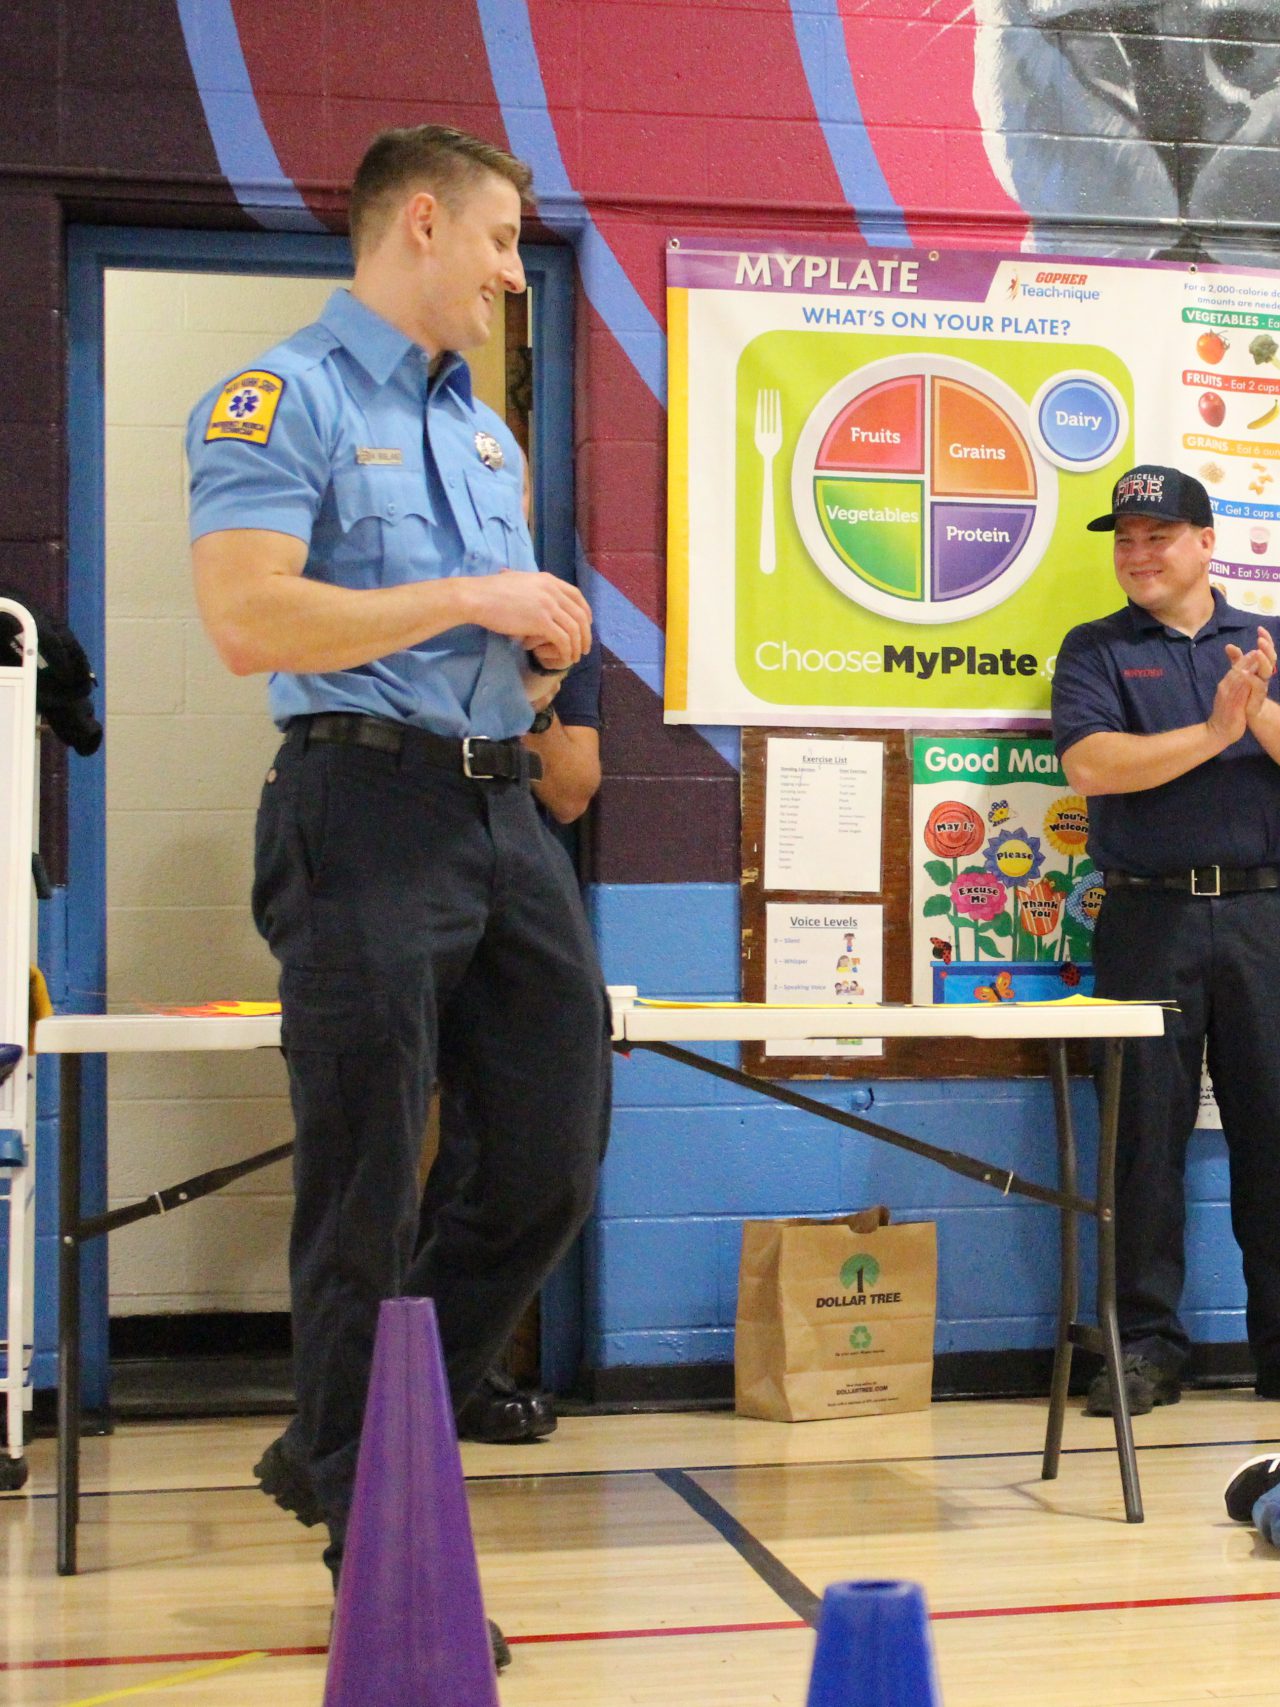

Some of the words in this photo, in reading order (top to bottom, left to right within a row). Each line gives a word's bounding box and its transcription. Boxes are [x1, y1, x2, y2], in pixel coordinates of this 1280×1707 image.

[735, 252, 919, 293] MYPLATE
[1035, 271, 1088, 285] GOPHER
[1198, 297, 1235, 306] amounts
[1237, 299, 1252, 307] are
[802, 307, 885, 327] WHAT'S
[892, 311, 927, 329] ON
[934, 313, 994, 332] YOUR
[1001, 317, 1071, 336] PLATE?
[1186, 309, 1259, 327] VEGETABLES
[1186, 372, 1223, 387] FRUITS
[1231, 379, 1246, 391] Eat
[1249, 381, 1256, 391] 2
[1257, 383, 1279, 394] cups
[1056, 410, 1102, 430] Dairy
[850, 427, 901, 444] Fruits
[949, 443, 1006, 460] Grains
[1186, 436, 1229, 453] GRAINS
[1236, 444, 1251, 454] Eat
[1254, 445, 1260, 455] 6
[826, 505, 919, 525] Vegetables
[1225, 504, 1241, 515] Get
[1244, 506, 1250, 516] 3
[1252, 508, 1274, 519] cups
[946, 526, 1010, 543] Protein
[1238, 567, 1252, 578] Eat
[802, 755, 833, 764] Exercise
[835, 756, 847, 764] List
[924, 746, 999, 773] Good
[936, 821, 959, 831] May
[959, 887, 999, 896] Excuse
[970, 895, 987, 904] Me
[1022, 900, 1058, 909] Thank
[790, 916, 821, 927] Voice
[824, 916, 858, 927] Levels
[1030, 909, 1051, 918] You
[816, 1294, 867, 1308] DOLLAR
[869, 1292, 901, 1305] TREE
